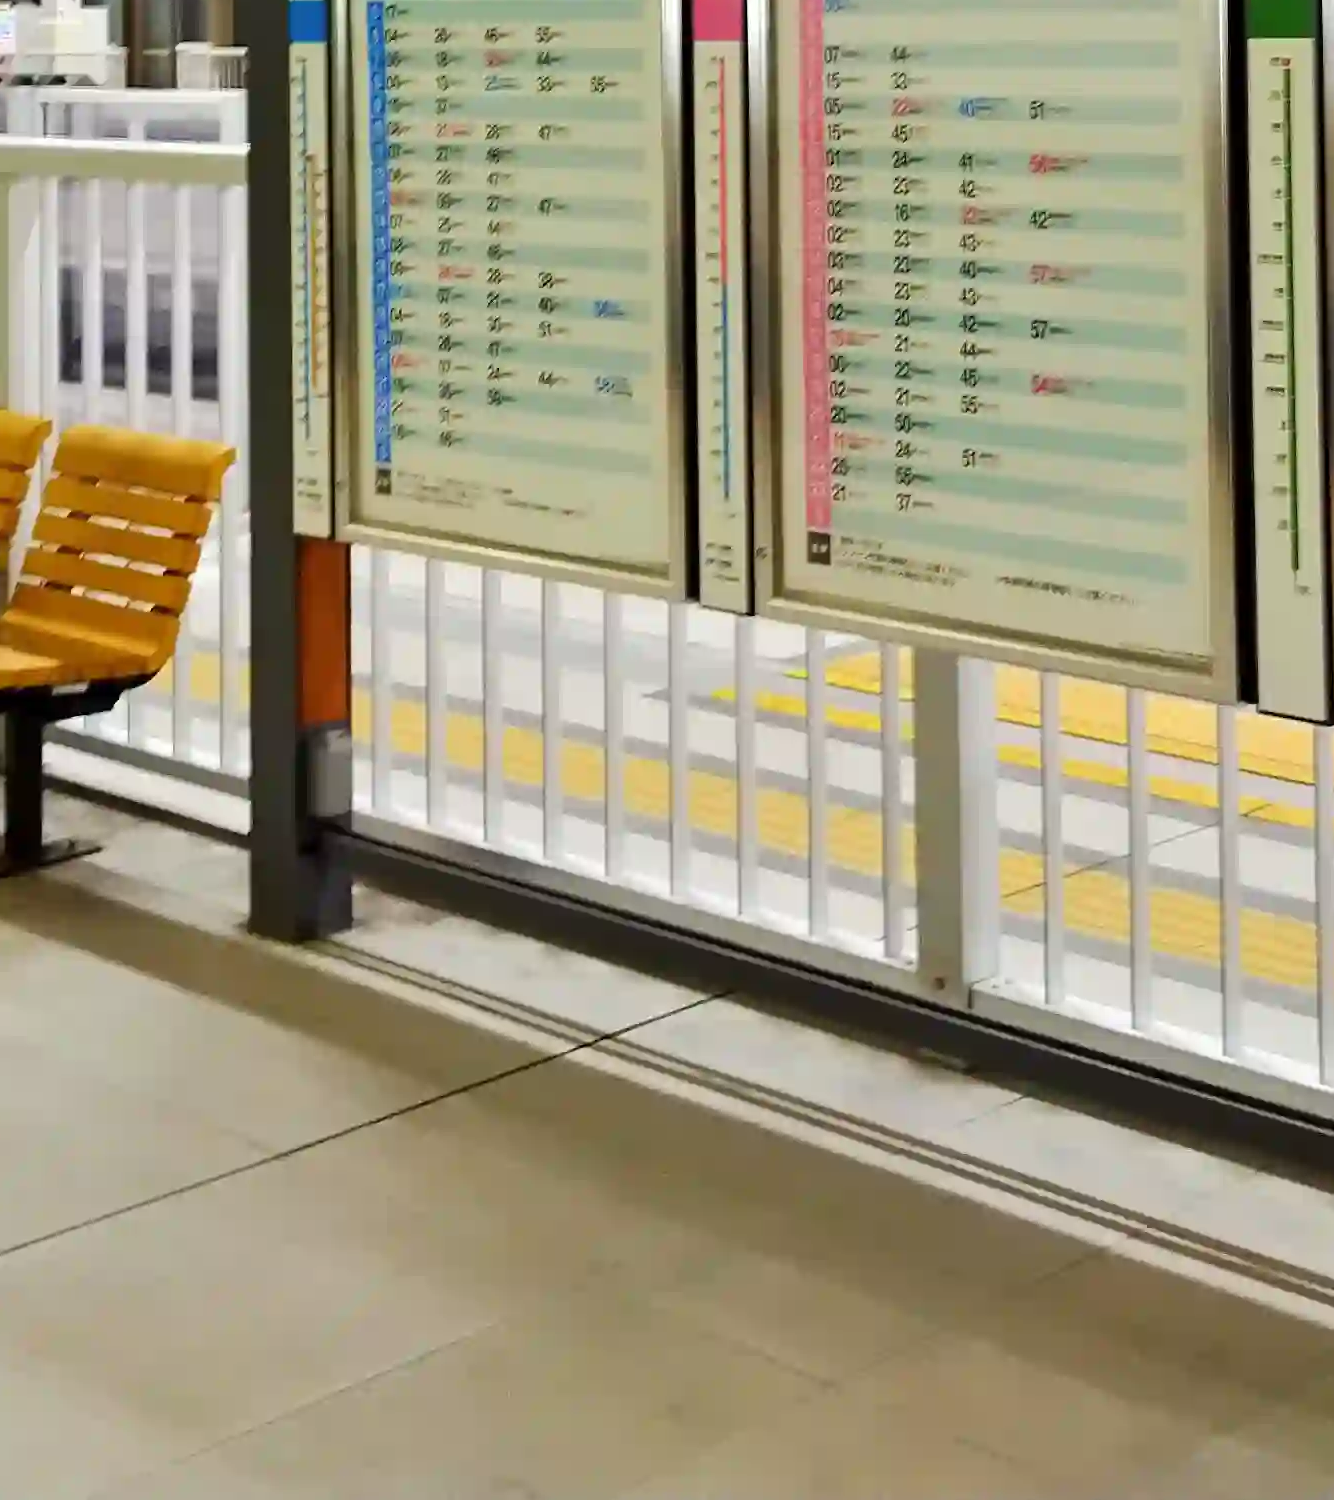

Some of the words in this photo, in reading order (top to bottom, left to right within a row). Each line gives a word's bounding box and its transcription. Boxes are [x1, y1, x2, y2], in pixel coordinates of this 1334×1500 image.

[824, 46, 840, 63] 07
[828, 73, 841, 89] 15
[828, 124, 841, 142] 15
[828, 278, 843, 296] 04
[828, 303, 844, 321] 02
[1031, 320, 1048, 339] 57
[895, 335, 910, 353] 21
[895, 387, 911, 405] 21
[895, 414, 912, 433] 50
[962, 449, 977, 467] 51
